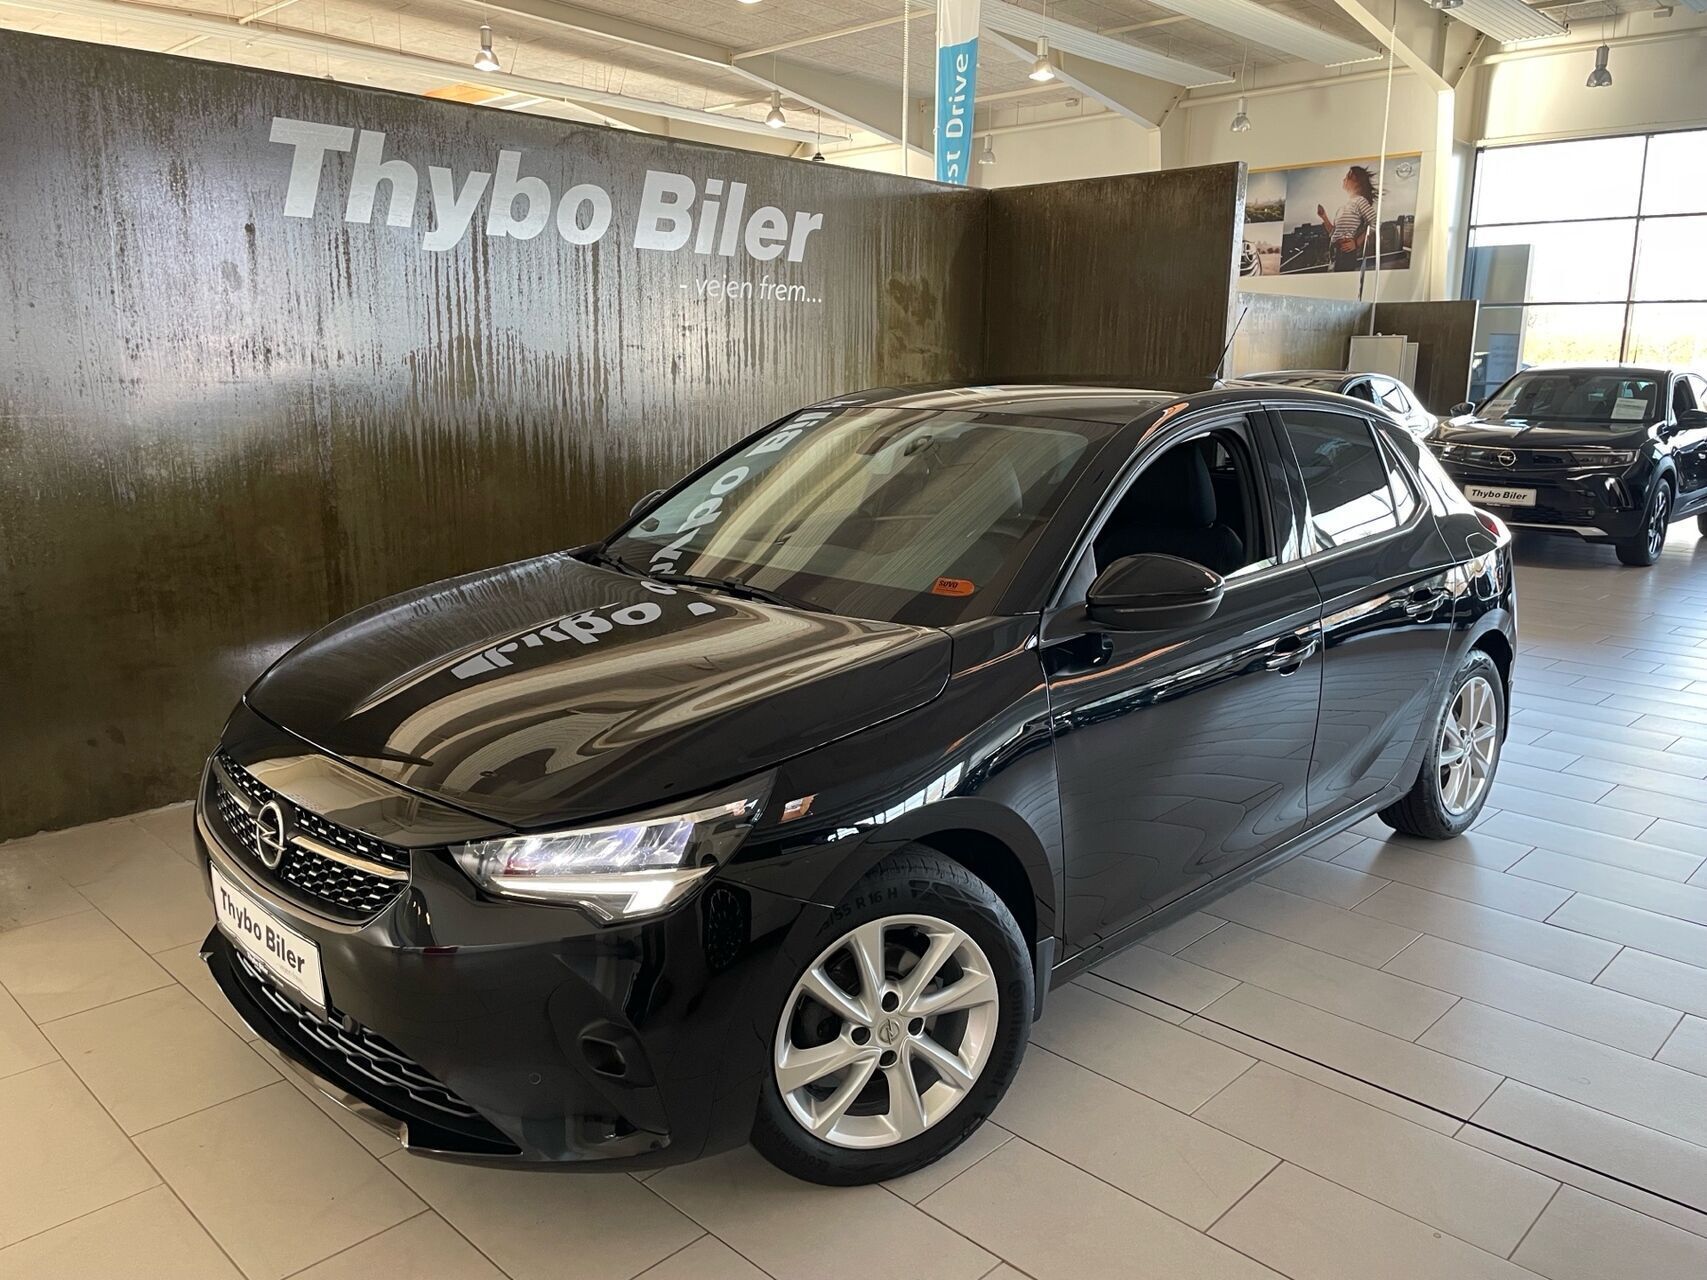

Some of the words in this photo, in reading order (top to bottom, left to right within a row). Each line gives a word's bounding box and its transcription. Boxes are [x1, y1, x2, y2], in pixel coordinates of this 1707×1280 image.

[945, 53, 969, 138] Drive
[269, 117, 612, 252] Thybo
[633, 169, 824, 263] Biler
[695, 275, 757, 302] vejen
[759, 274, 823, 304] frem...
[1472, 489, 1500, 498] Thybo
[1503, 491, 1527, 499] Biler
[856, 896, 866, 909] R
[868, 889, 882, 904] 16
[887, 887, 898, 899] H
[220, 886, 262, 940] Thybo
[265, 924, 306, 974] Biler
